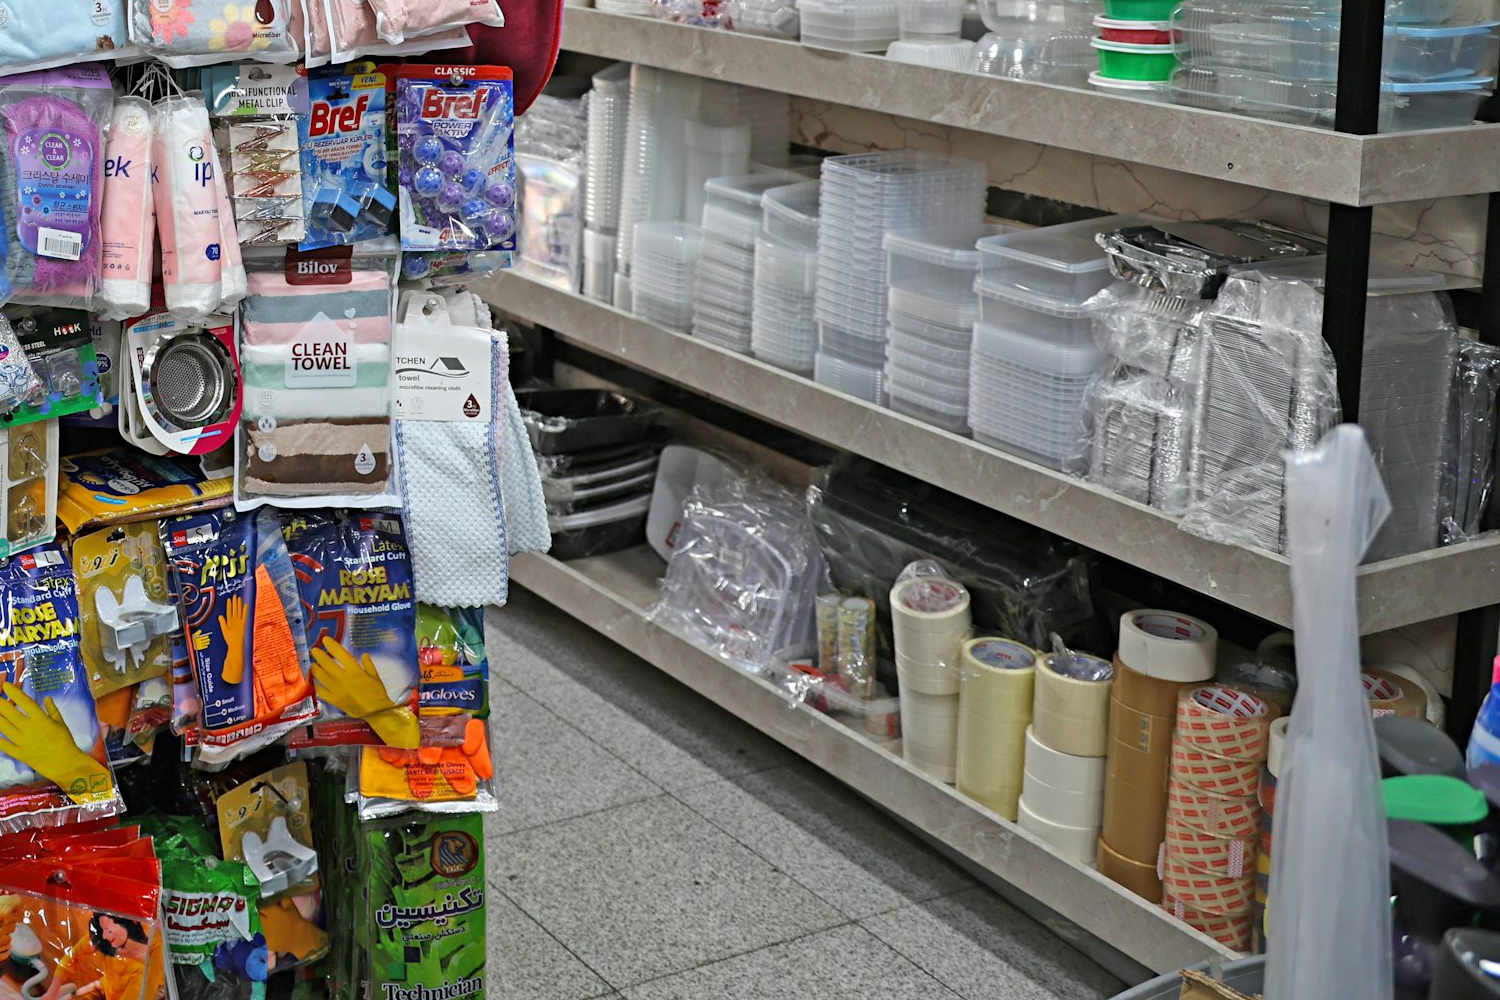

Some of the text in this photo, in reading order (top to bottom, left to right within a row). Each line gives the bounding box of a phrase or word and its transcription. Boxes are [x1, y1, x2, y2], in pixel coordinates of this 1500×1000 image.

[95, 2, 102, 13] 3
[434, 67, 476, 76] CLASSIC
[225, 86, 297, 98] MULTIFUNCTIONAL
[238, 98, 284, 108] METAL CLIP
[421, 87, 490, 119] Bref
[309, 94, 370, 137] Bref
[436, 129, 470, 137] AKTIV
[45, 141, 63, 149] CLEAN
[22, 170, 89, 185] 크리스탈 수세미
[211, 247, 219, 255] 70
[297, 261, 338, 275] Bilov
[292, 343, 347, 357] CLEAN
[292, 357, 351, 370] TOWEL
[466, 400, 473, 408] 3
[359, 452, 367, 463] 3
[381, 521, 394, 532] M
[174, 535, 186, 543] Size
[371, 541, 405, 553] Latex
[21, 552, 54, 566] Size L
[344, 551, 406, 567] Standard Cuff
[35, 577, 70, 588] Latex
[340, 566, 387, 586] ROSE
[12, 586, 72, 605] Standard Cuff
[318, 582, 411, 607] MARYAM
[12, 602, 57, 625] ROSE
[347, 601, 412, 614] Household Glove
[205, 673, 214, 693] Guide
[376, 887, 485, 929] تکنیسین
[402, 927, 466, 943] دستکش صنعتی
[382, 977, 483, 1000] Technician
